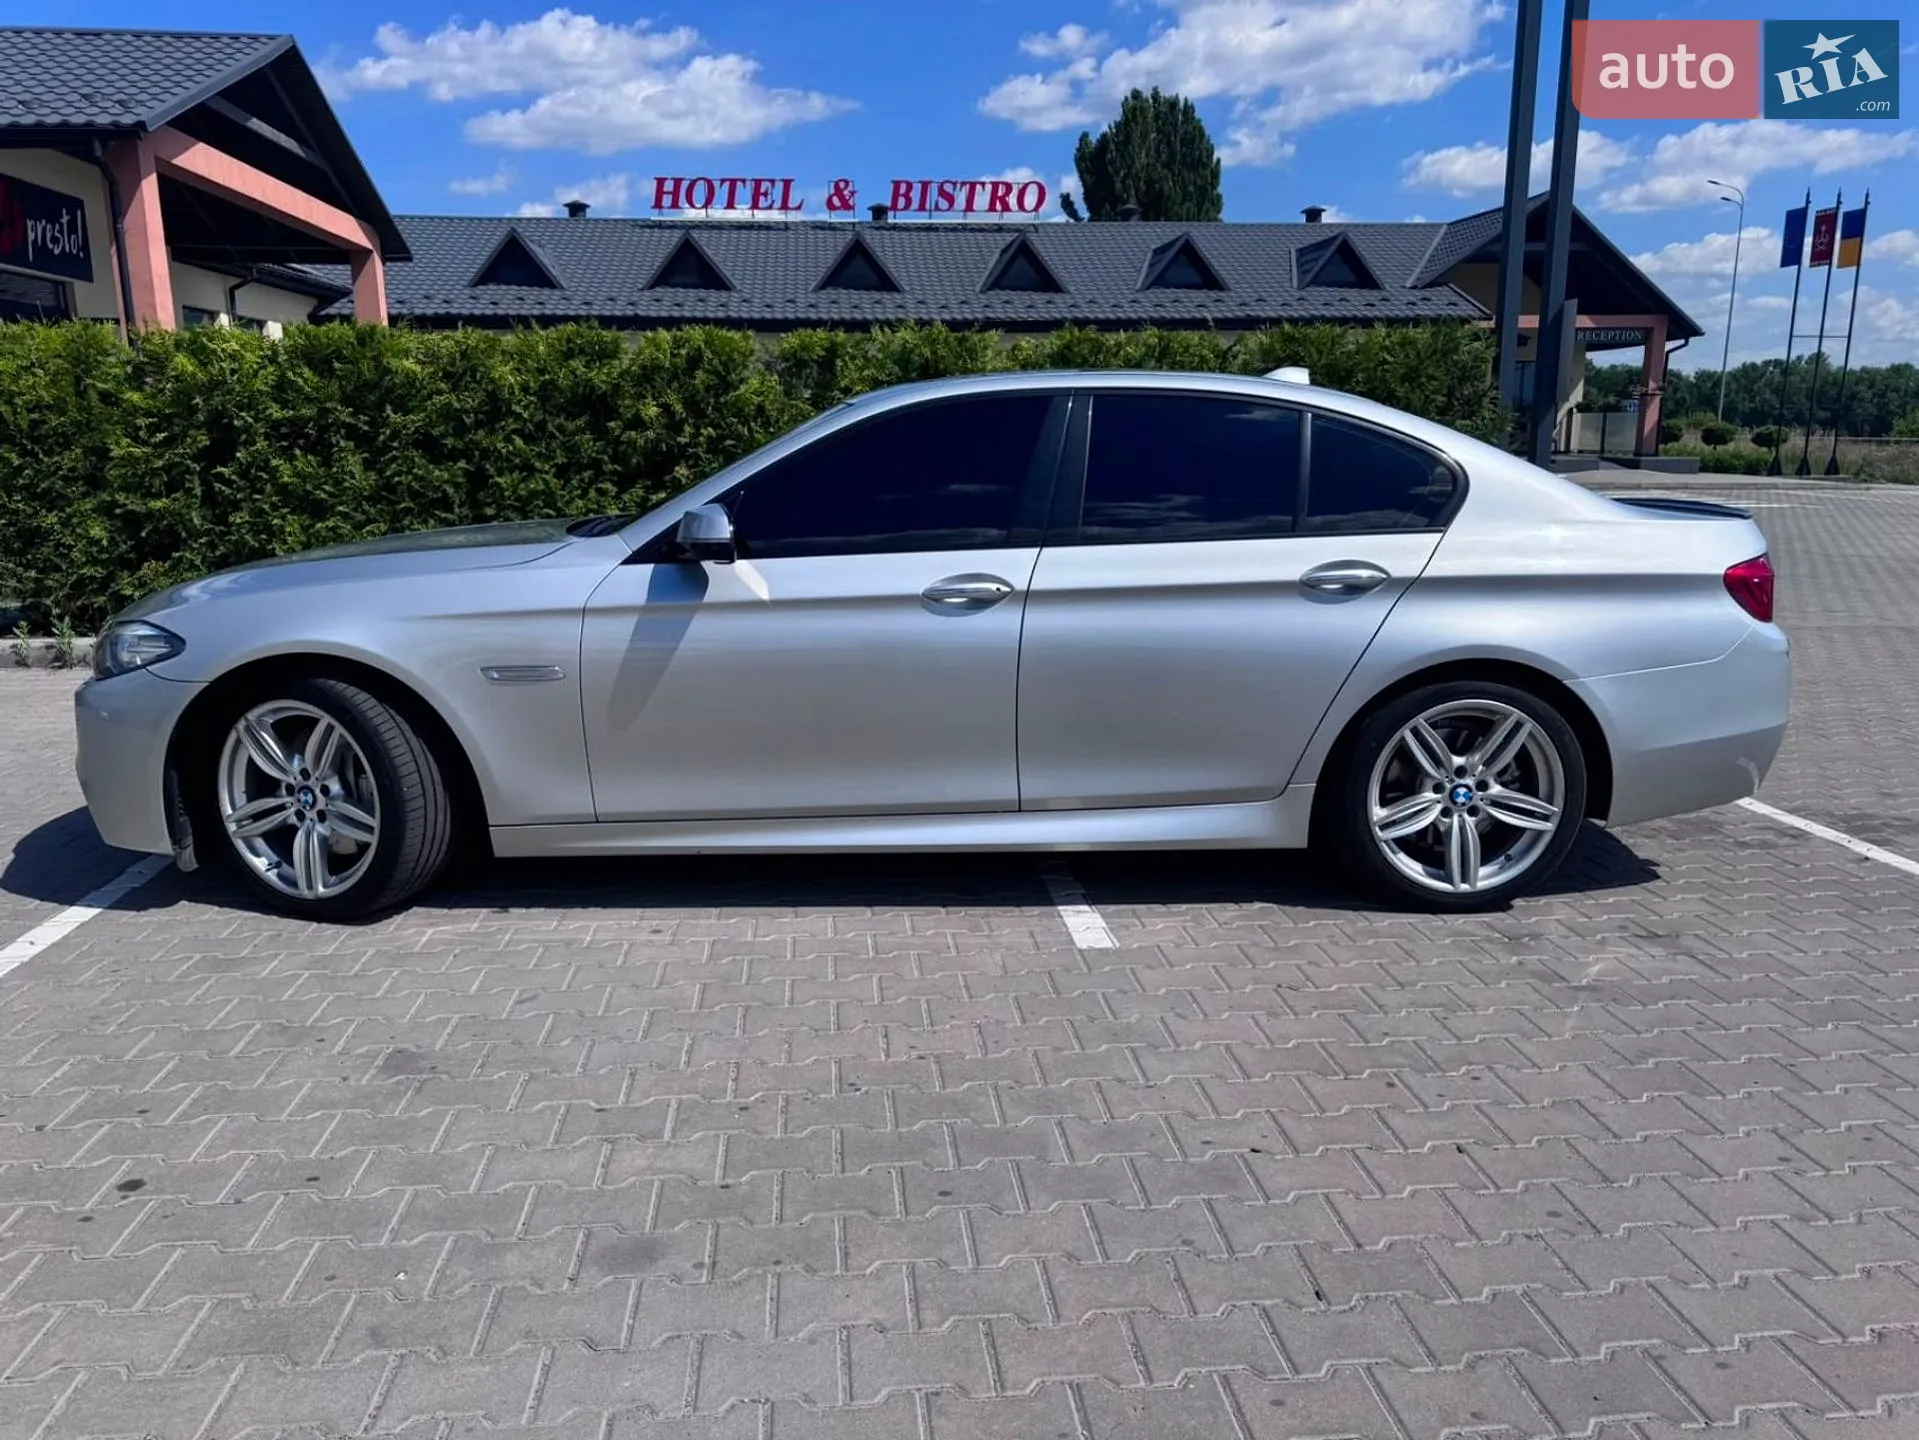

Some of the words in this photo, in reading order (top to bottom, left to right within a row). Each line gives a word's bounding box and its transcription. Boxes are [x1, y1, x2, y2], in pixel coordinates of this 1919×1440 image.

[651, 177, 804, 211] HOTEL
[825, 178, 857, 212] &
[888, 179, 1047, 213] BISTRO
[26, 207, 84, 262] presto!
[1577, 329, 1643, 341] RECEPTION
